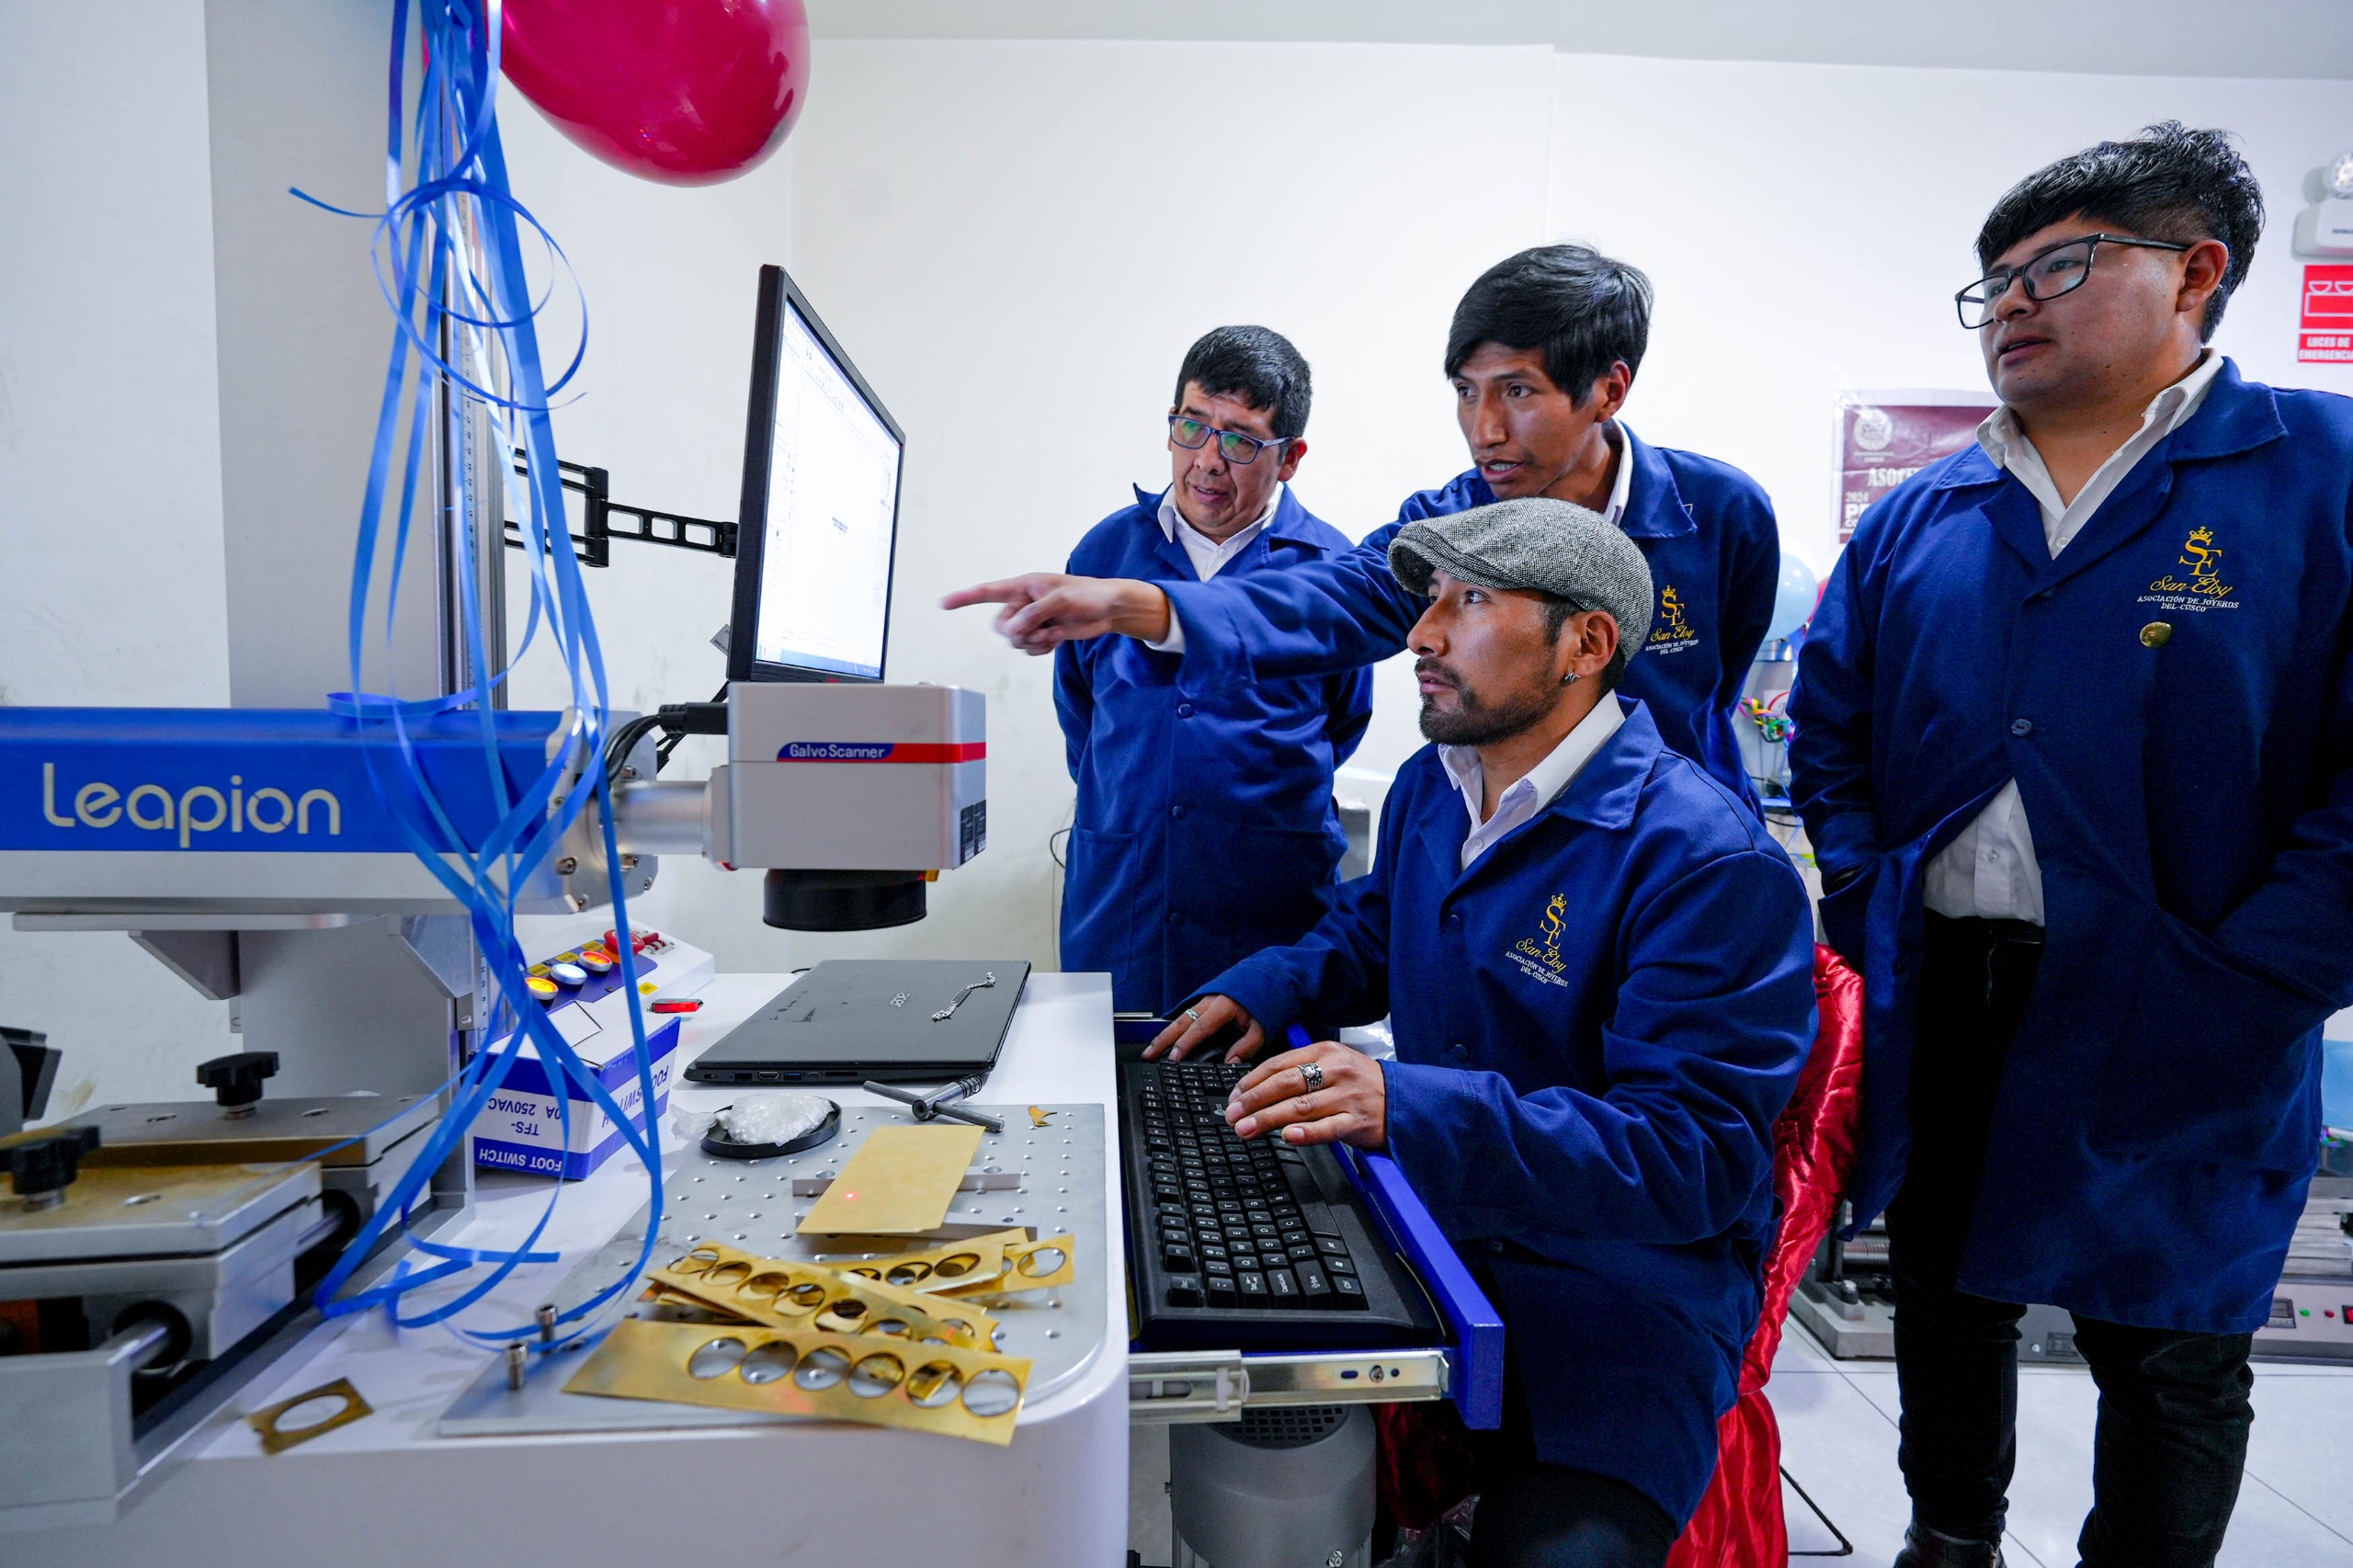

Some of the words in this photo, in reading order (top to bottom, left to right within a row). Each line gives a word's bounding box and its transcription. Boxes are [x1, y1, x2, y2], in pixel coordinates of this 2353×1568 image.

[1868, 467, 1923, 486] ASOC
[2150, 575, 2188, 592] San
[2191, 576, 2234, 600] Eloy
[2137, 595, 2186, 604] ASOCIACIÓN
[2202, 598, 2240, 608] JOYEROS
[1650, 628, 1671, 642] San
[1673, 625, 1695, 642] Eloy
[43, 762, 341, 848] Leapion
[1505, 950, 1539, 971] ASOCIACIÓN
[1516, 937, 1541, 958] San
[1542, 948, 1567, 974] Eloy
[651, 1065, 669, 1091] FOO
[488, 1097, 537, 1116] 250VAC
[601, 1085, 643, 1129] SWIH
[510, 1121, 540, 1136] TFS-
[479, 1148, 527, 1166] SWITCH
[529, 1156, 563, 1172] FOOT
